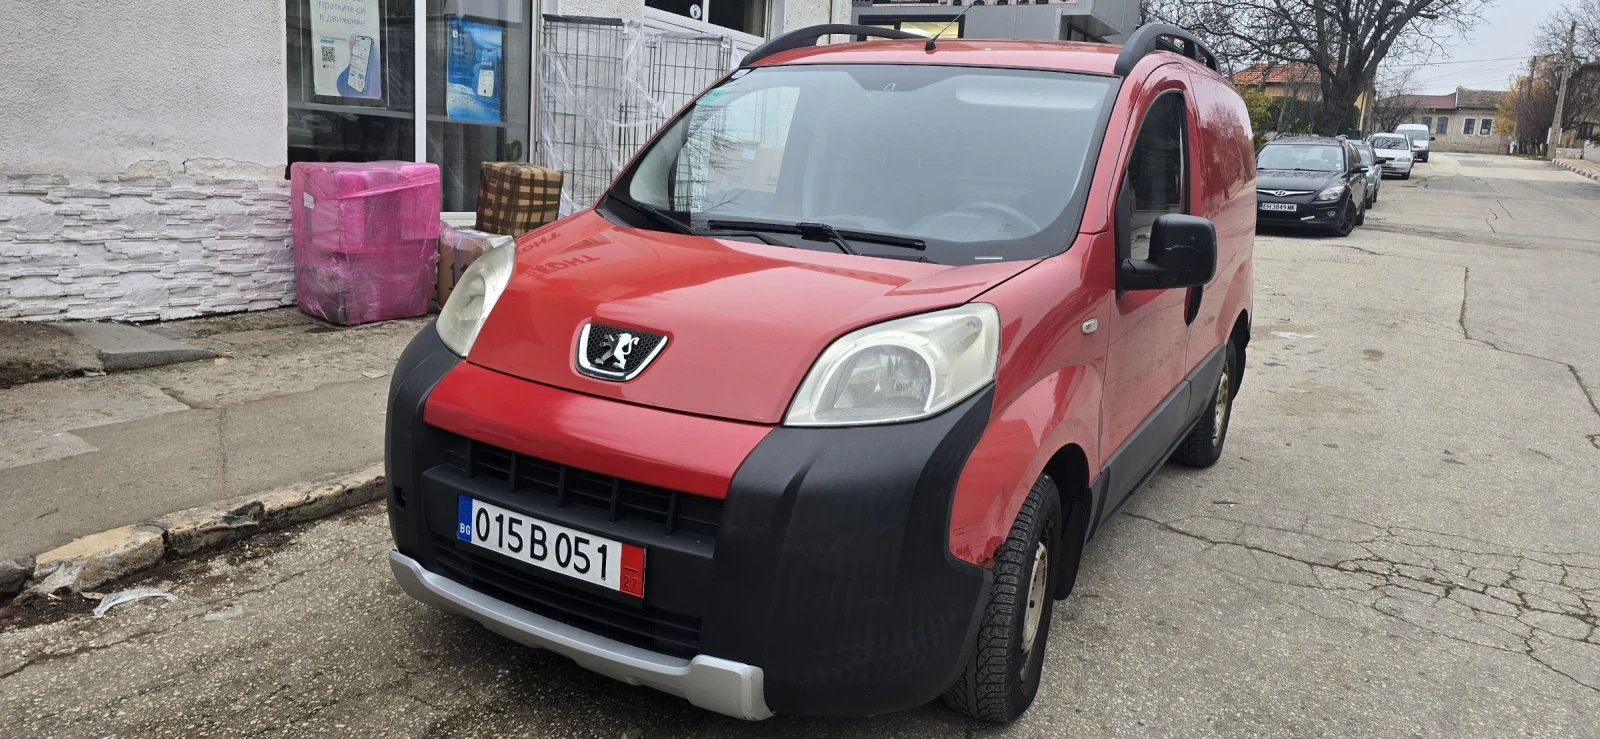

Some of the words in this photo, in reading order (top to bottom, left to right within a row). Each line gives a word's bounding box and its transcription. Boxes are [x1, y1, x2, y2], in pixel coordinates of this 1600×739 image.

[319, 2, 354, 13] пратките
[327, 15, 365, 26] движение
[459, 523, 471, 536] BG
[623, 575, 639, 591] 27
